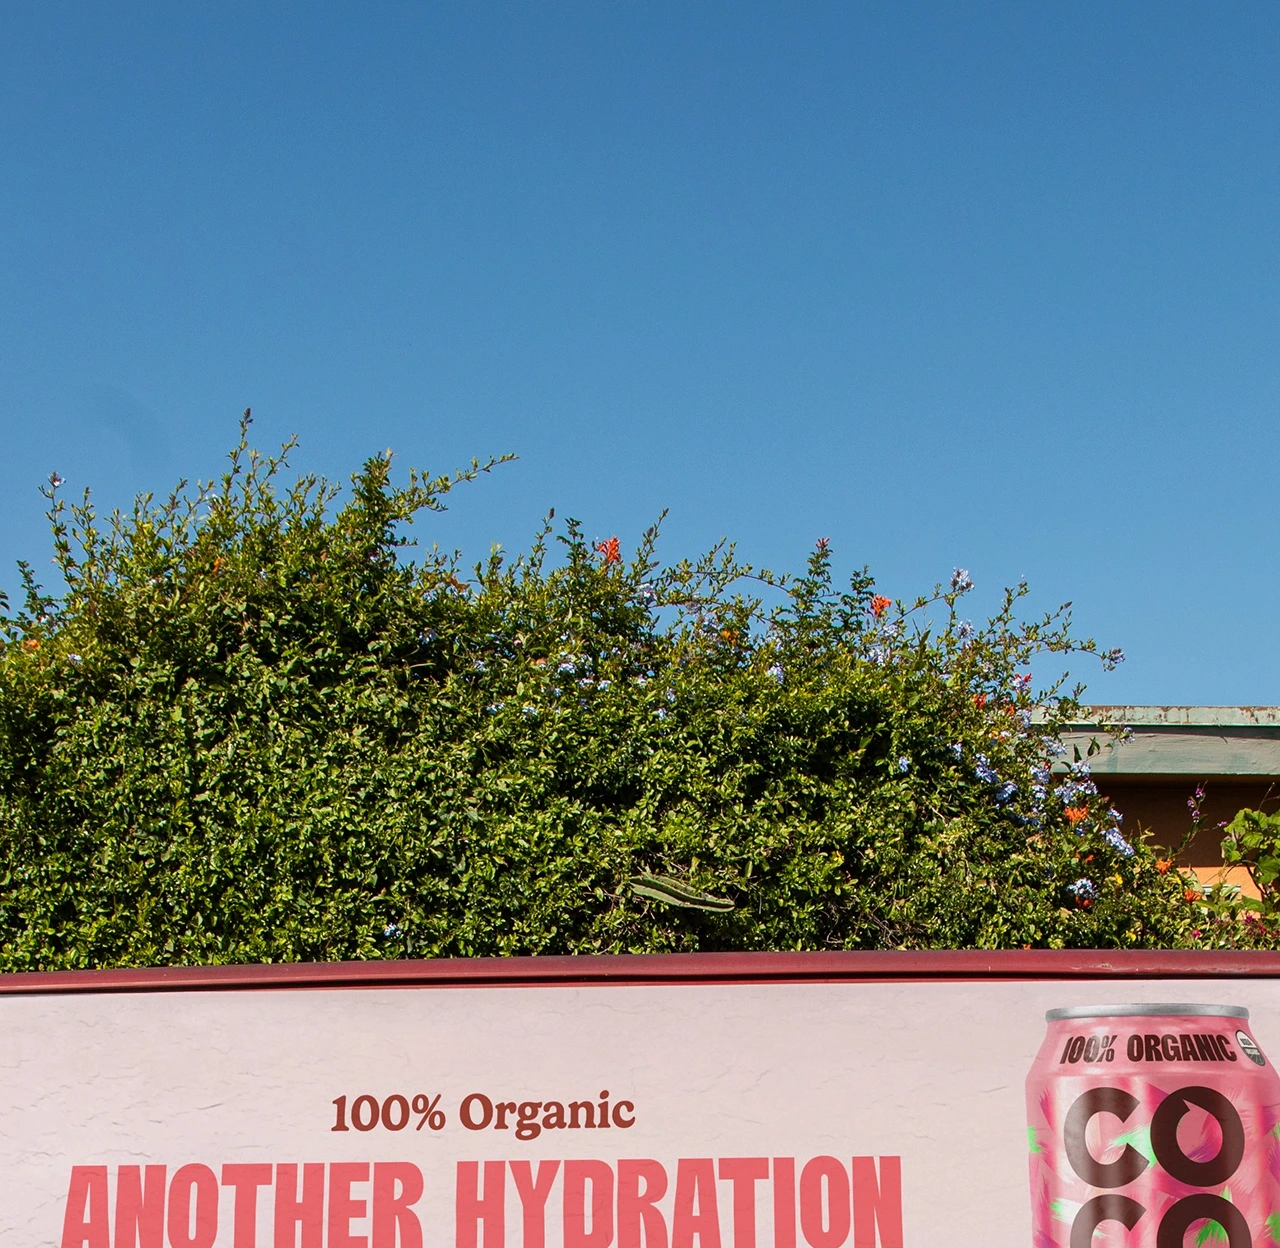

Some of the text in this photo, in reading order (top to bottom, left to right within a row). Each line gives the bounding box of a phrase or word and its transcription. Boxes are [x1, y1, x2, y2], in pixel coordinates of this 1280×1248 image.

[1060, 1033, 1238, 1065] 100% ORGANIC
[331, 1090, 636, 1141] 100% Organic
[1064, 1085, 1245, 1189] CO
